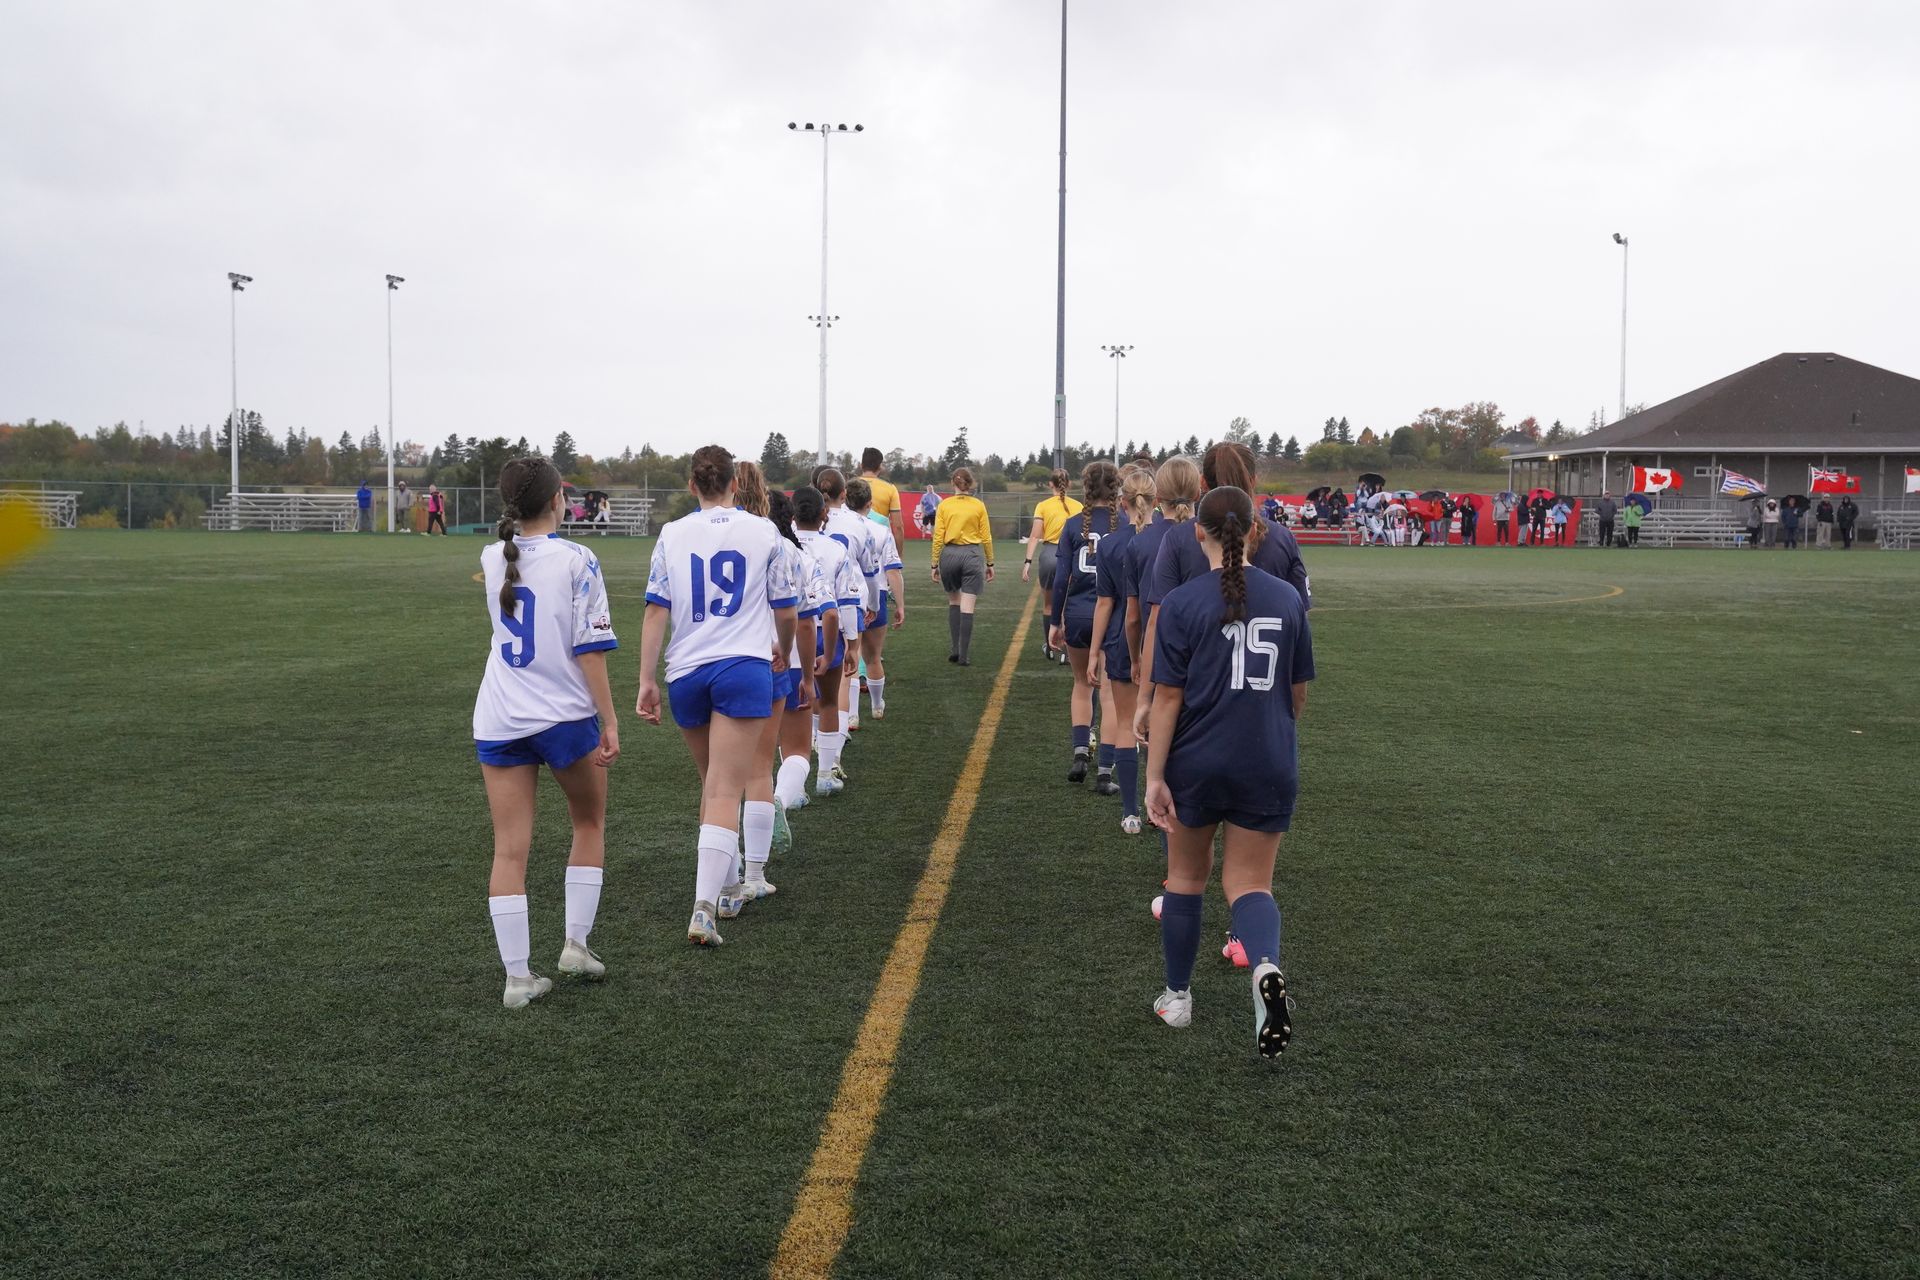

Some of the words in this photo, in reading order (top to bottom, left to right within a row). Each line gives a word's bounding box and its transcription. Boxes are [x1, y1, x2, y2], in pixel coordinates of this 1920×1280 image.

[691, 550, 746, 622] 19
[500, 586, 536, 668] 9
[1221, 617, 1282, 691] 15
